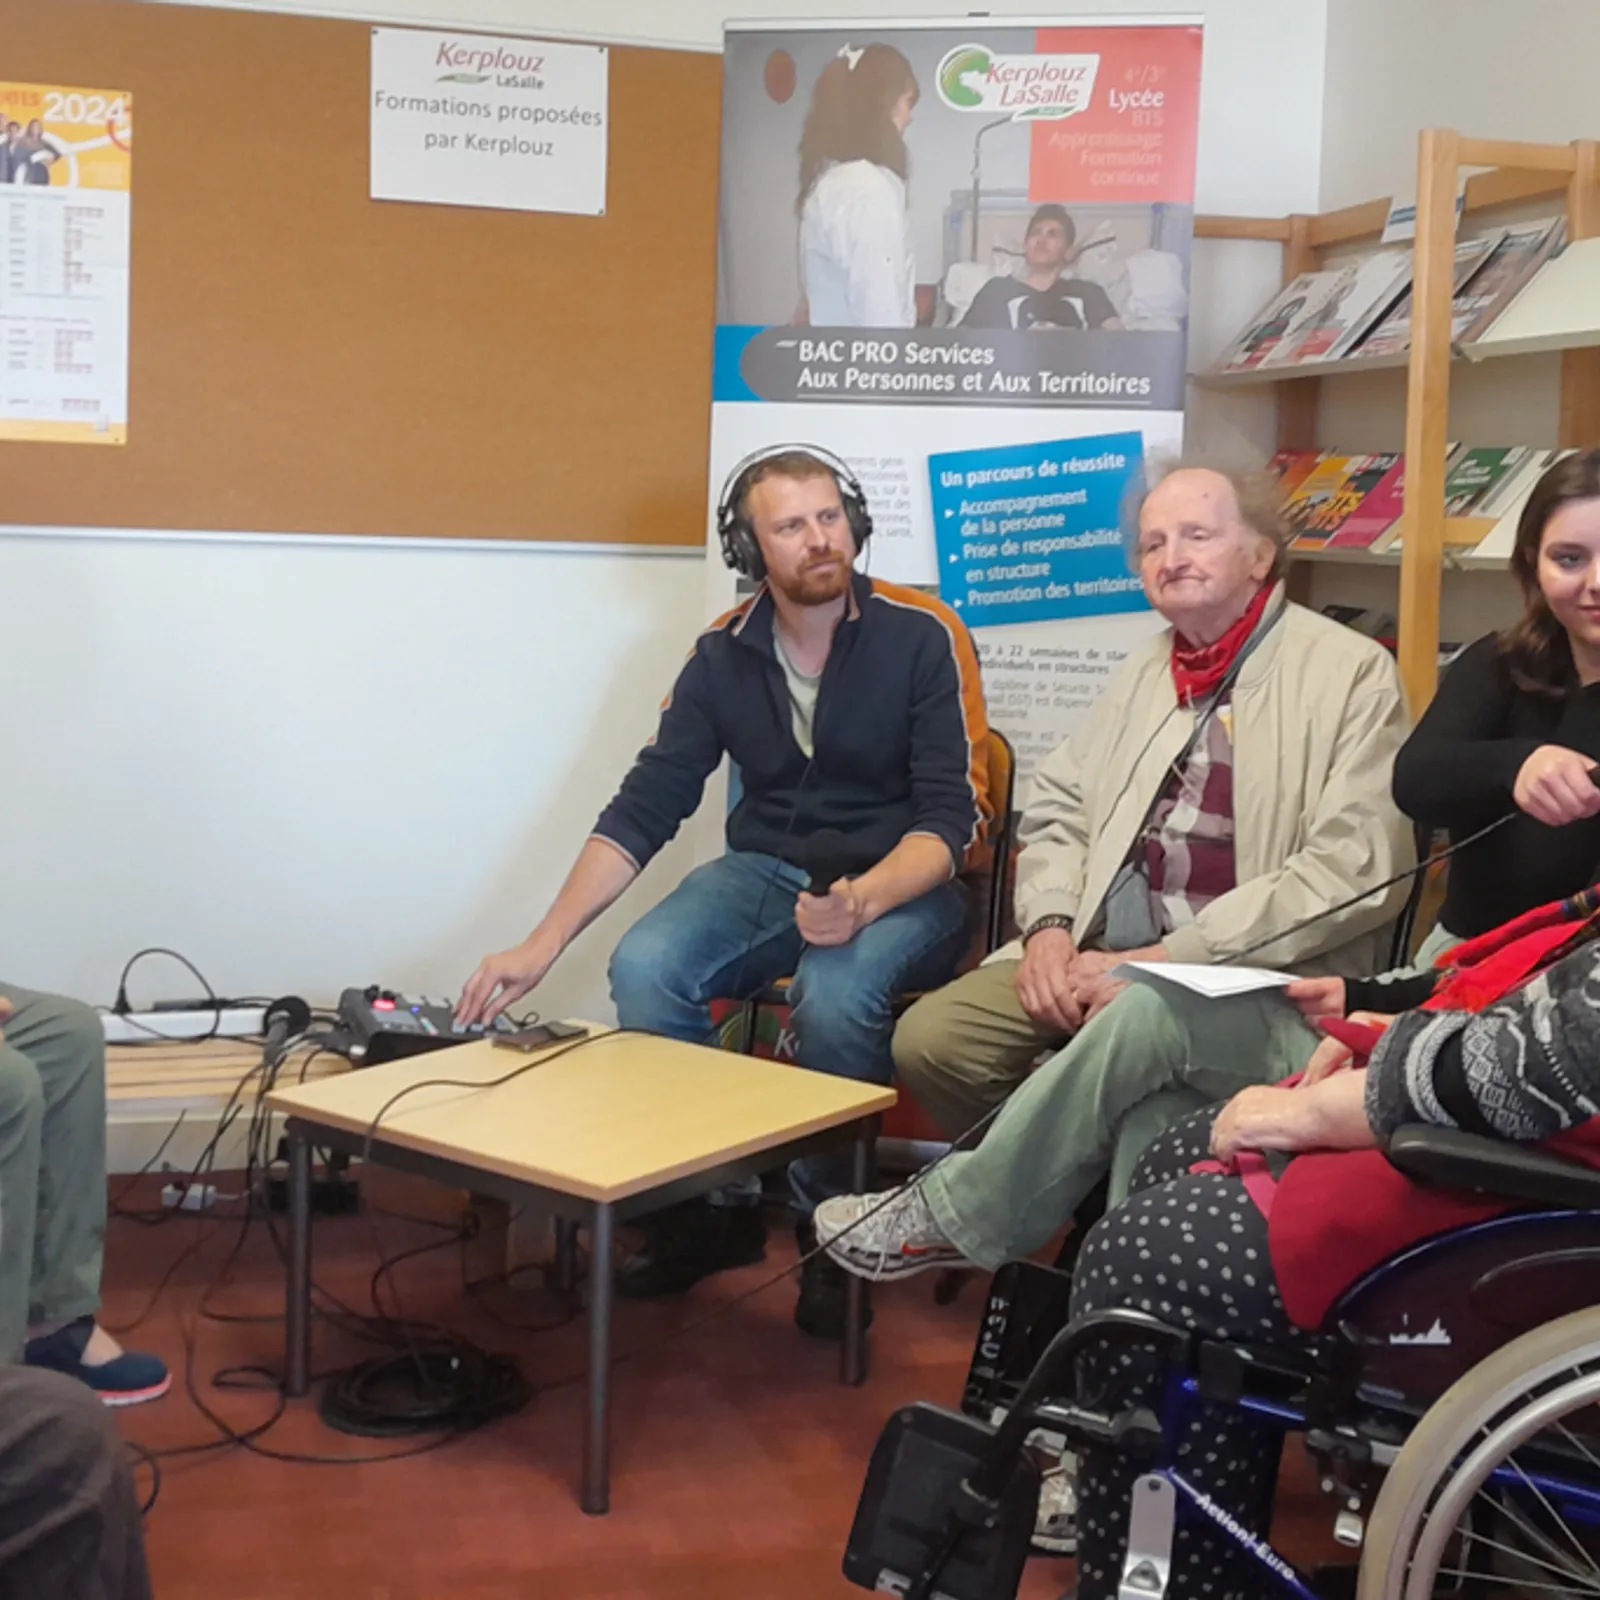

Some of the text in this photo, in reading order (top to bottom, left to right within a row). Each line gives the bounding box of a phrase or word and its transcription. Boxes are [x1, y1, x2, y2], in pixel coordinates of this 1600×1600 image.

[435, 41, 545, 72] Kerplouz
[496, 74, 545, 90] LaSalle
[985, 61, 1088, 87] Kerplouz
[1000, 84, 1080, 107] LaSalle
[1109, 88, 1165, 113] Lycée
[43, 91, 127, 126] 2024
[374, 90, 603, 126] Formations proposées
[1132, 110, 1164, 127] BTS
[424, 132, 554, 156] par Kerplouz
[1049, 130, 1163, 150] Apprentissage
[1080, 149, 1162, 166] Formation
[1090, 170, 1161, 186] continue
[799, 340, 995, 365] BAC PRO Services
[797, 367, 1151, 395] Aux Personnes et Aux Territoires
[941, 452, 1126, 489] Un parcours de réussite
[959, 488, 1087, 517] Accompagnement
[961, 513, 1066, 536] de la personne
[963, 542, 997, 559] Prise
[1001, 539, 1019, 556] de
[966, 562, 1050, 583] en structure
[968, 585, 1042, 607] Promotion
[1045, 581, 1071, 599] des
[1029, 646, 1080, 659] semaines
[1085, 648, 1100, 660] de
[1054, 663, 1110, 676] structures
